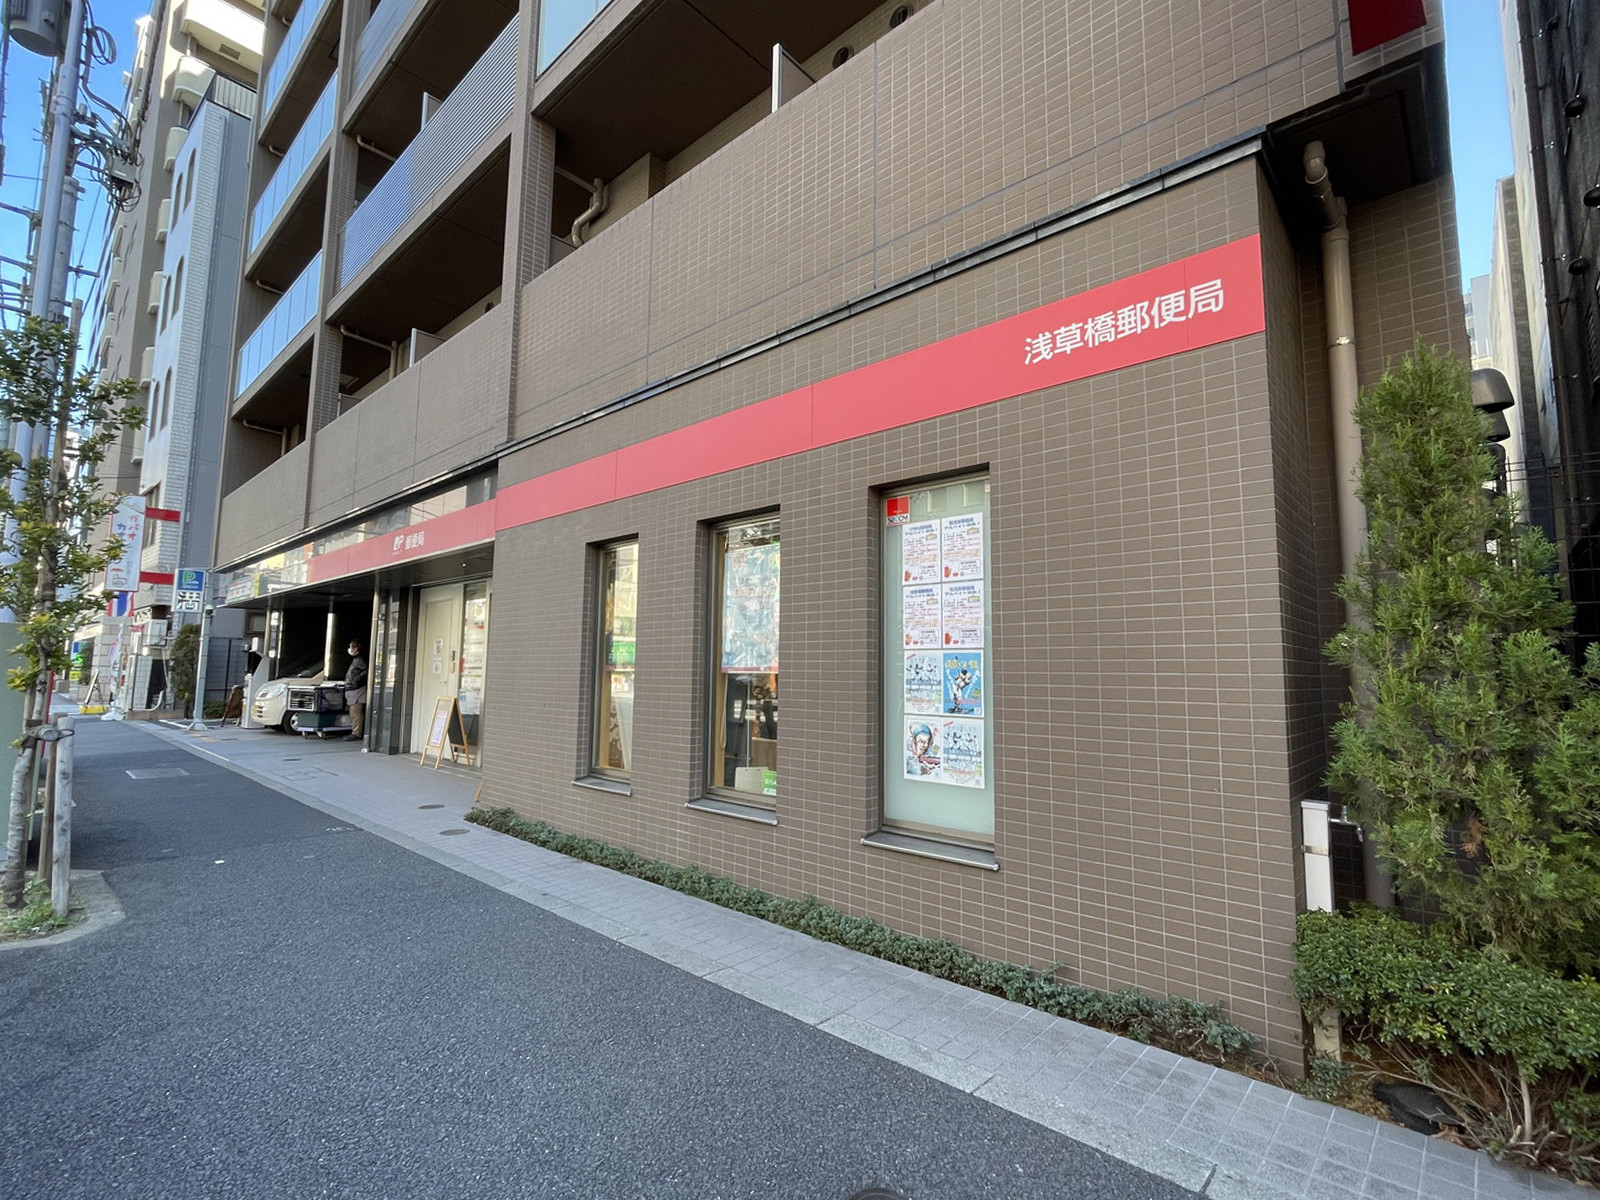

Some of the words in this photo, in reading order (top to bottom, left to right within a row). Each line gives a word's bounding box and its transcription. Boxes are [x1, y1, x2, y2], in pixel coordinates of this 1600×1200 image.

[1024, 278, 1224, 365] 浅草橋郵便局
